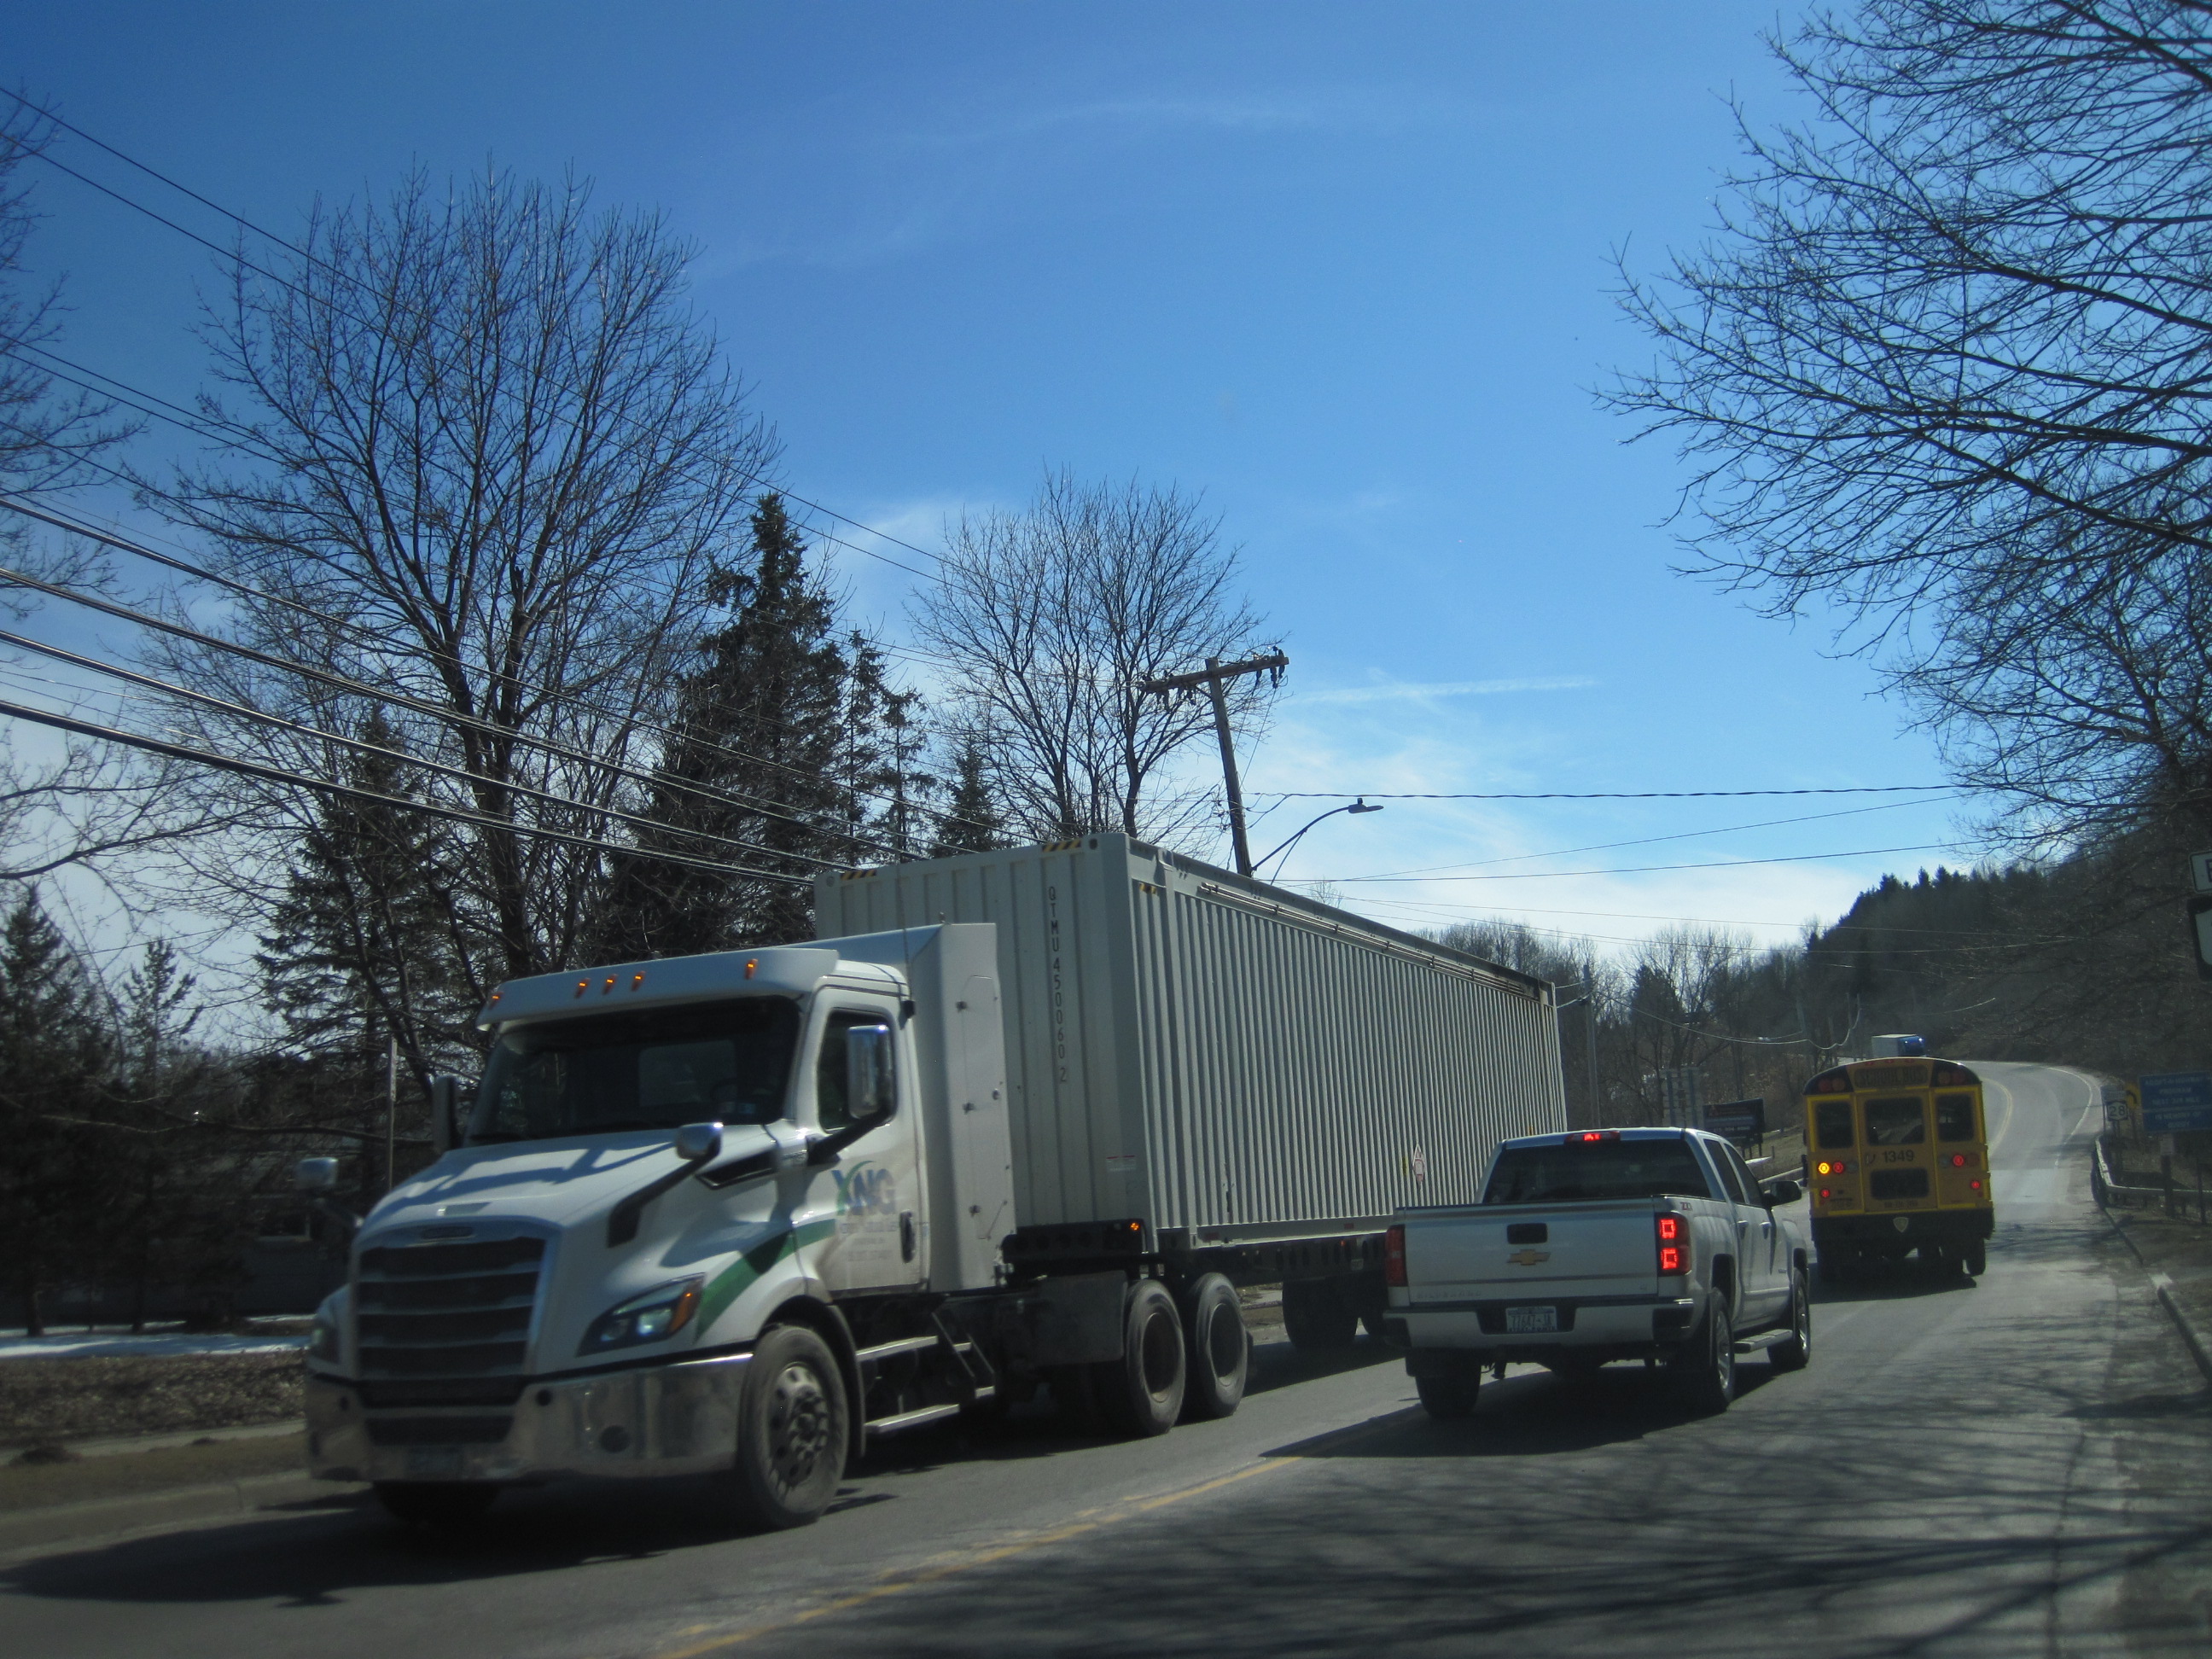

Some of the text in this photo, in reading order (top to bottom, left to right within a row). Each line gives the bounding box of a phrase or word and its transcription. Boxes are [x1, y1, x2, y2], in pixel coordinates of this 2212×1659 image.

[1048, 886, 1068, 1082] QTMU 450060 2
[1859, 1066, 1926, 1086] SCHOOL BUS
[2110, 1105, 2126, 1116] 28
[1882, 1150, 1914, 1163] 1349
